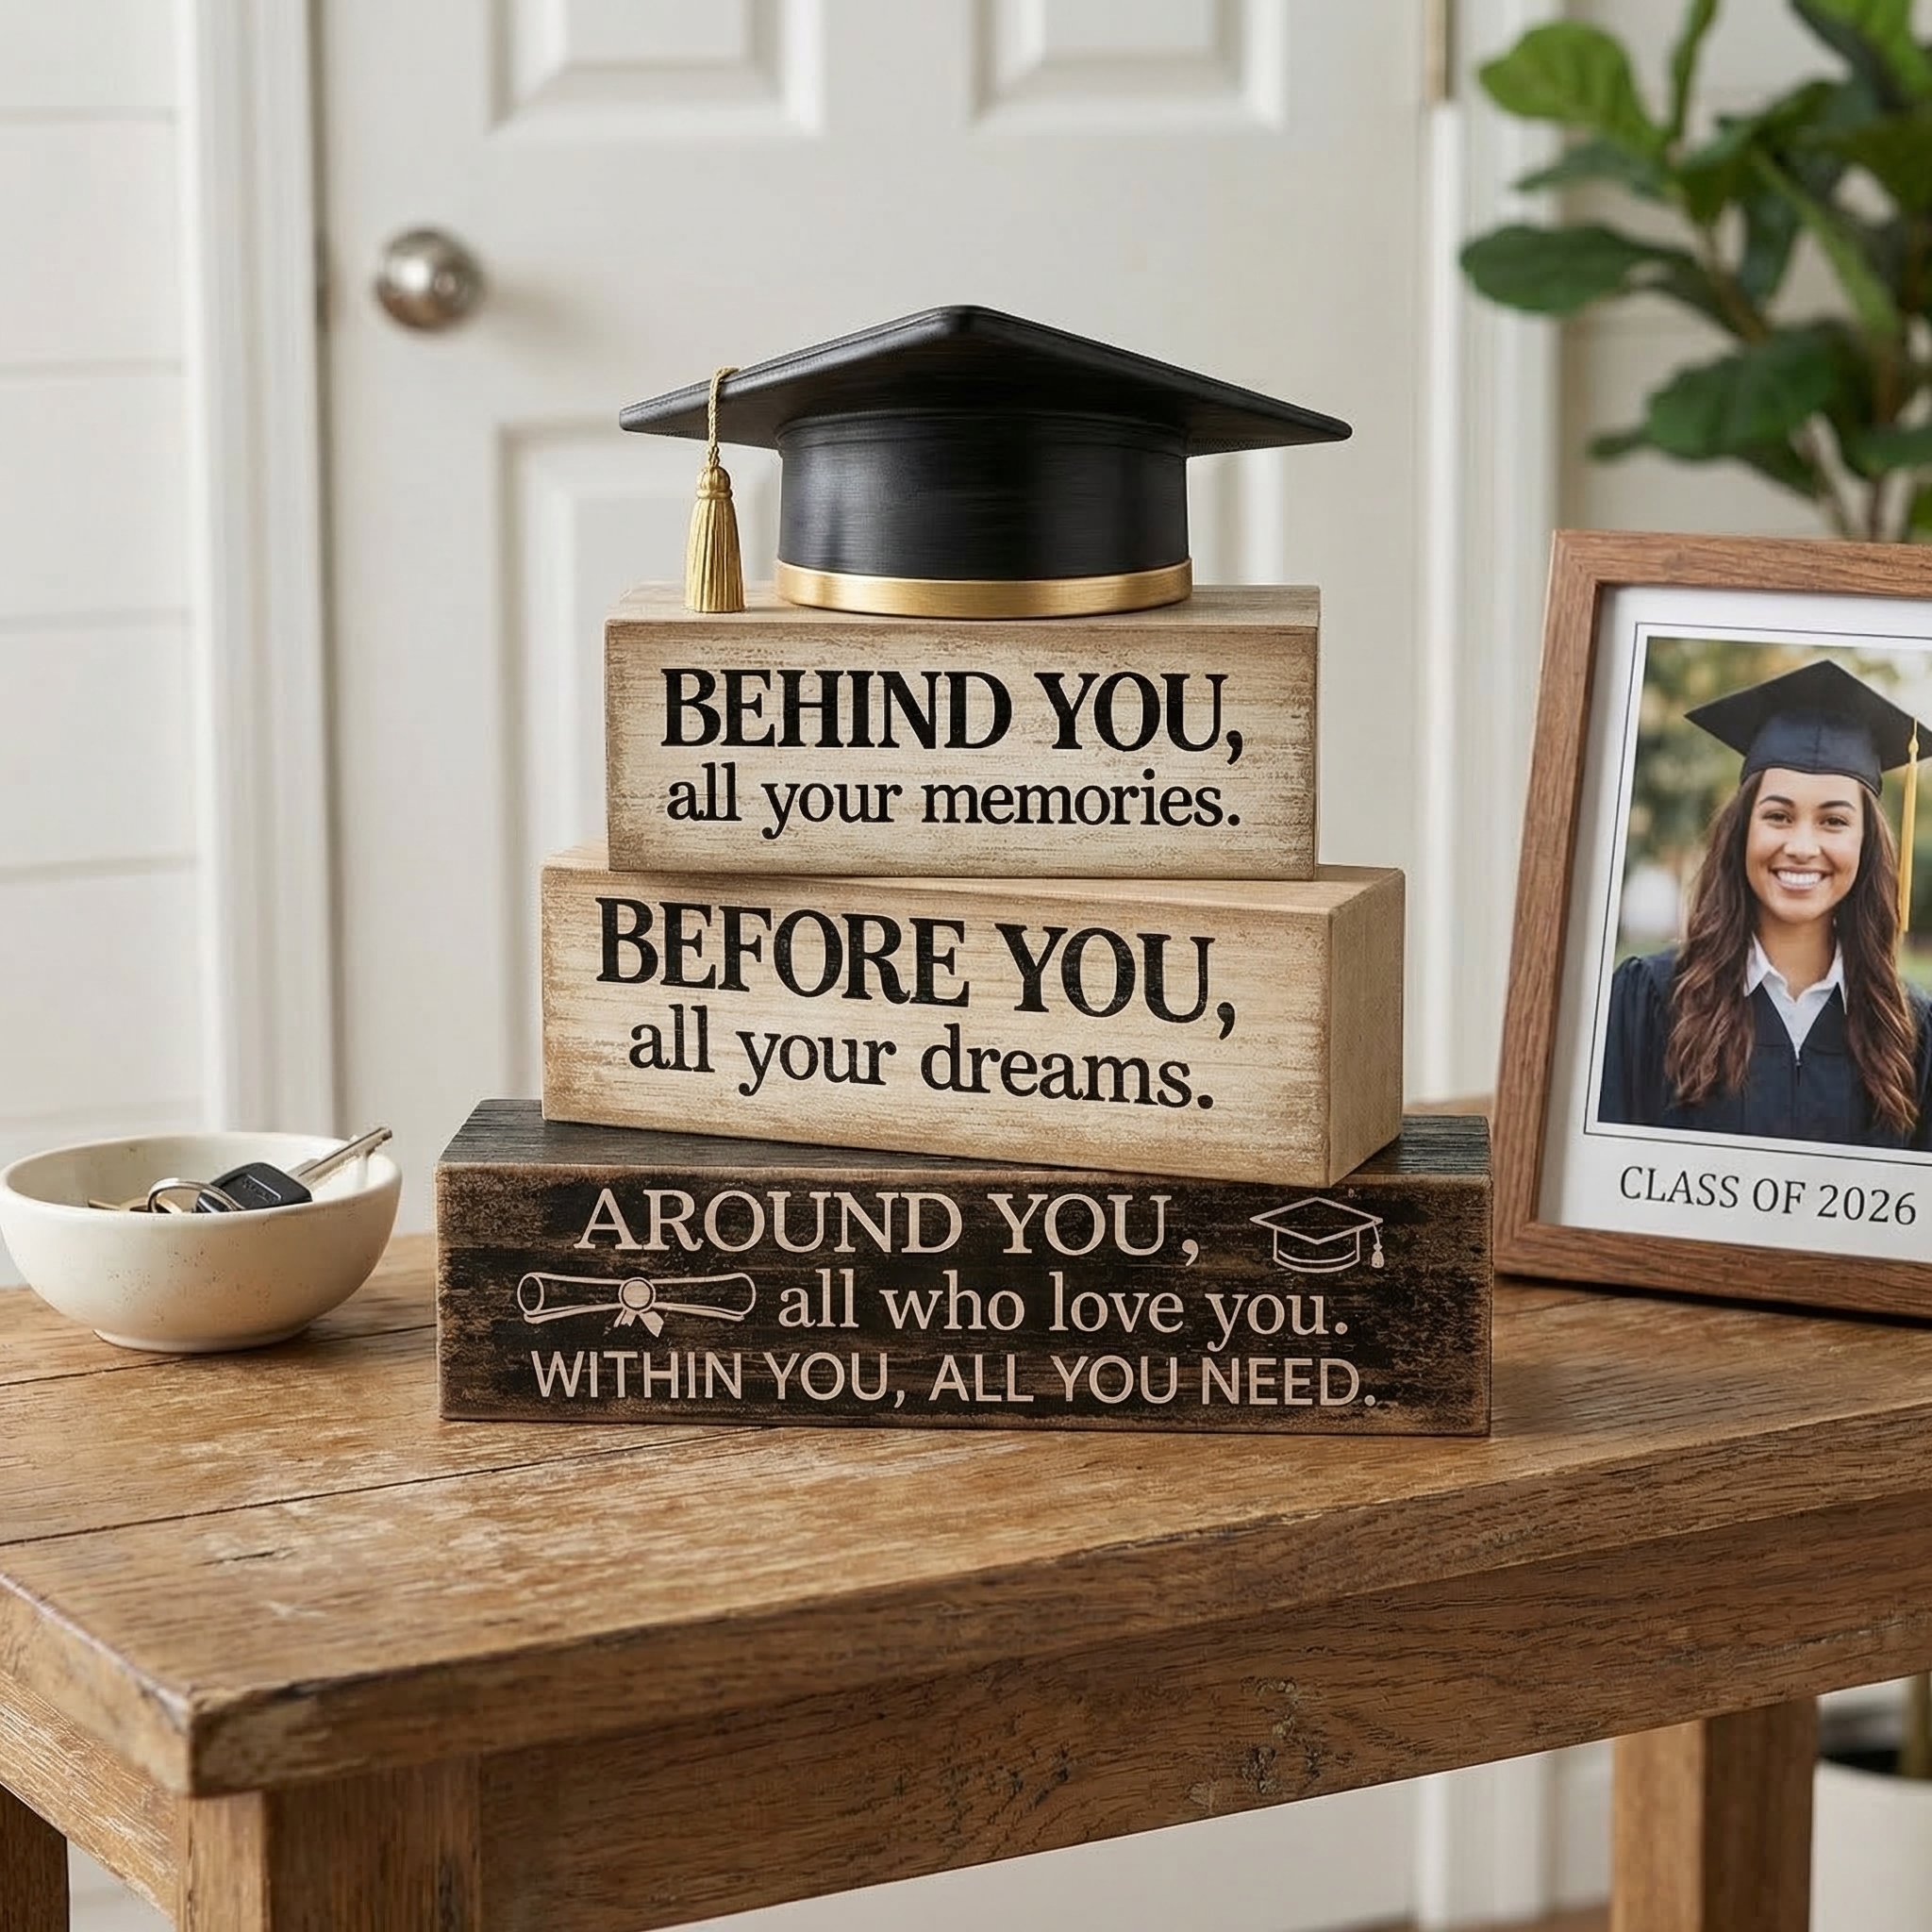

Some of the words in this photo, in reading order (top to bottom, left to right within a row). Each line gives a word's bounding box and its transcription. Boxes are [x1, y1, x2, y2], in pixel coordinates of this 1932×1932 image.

[660, 668, 1012, 750] BEHIND
[1033, 671, 1243, 766] YOU,
[666, 761, 742, 822] all
[760, 783, 904, 841] your
[920, 768, 1241, 827] memories.
[594, 896, 970, 1008] BEFORE
[993, 923, 1236, 1041] YOU,
[628, 1003, 716, 1074] all
[735, 1030, 897, 1097] your
[920, 1023, 1214, 1109] dreams.
[573, 1188, 963, 1254] AROUND
[987, 1192, 1199, 1267] YOU,
[1620, 1166, 1740, 1208] CLASS
[1753, 1177, 1807, 1214] OF
[1817, 1184, 1916, 1225] 2026
[778, 1268, 859, 1328] all
[878, 1269, 1025, 1331] who
[1048, 1271, 1185, 1333] love
[1204, 1292, 1348, 1353] you.
[530, 1350, 741, 1400] WITHIN
[762, 1351, 906, 1408] YOU,
[928, 1354, 1035, 1402] ALL
[1050, 1355, 1178, 1405] YOU
[1202, 1357, 1376, 1407] NEED.
